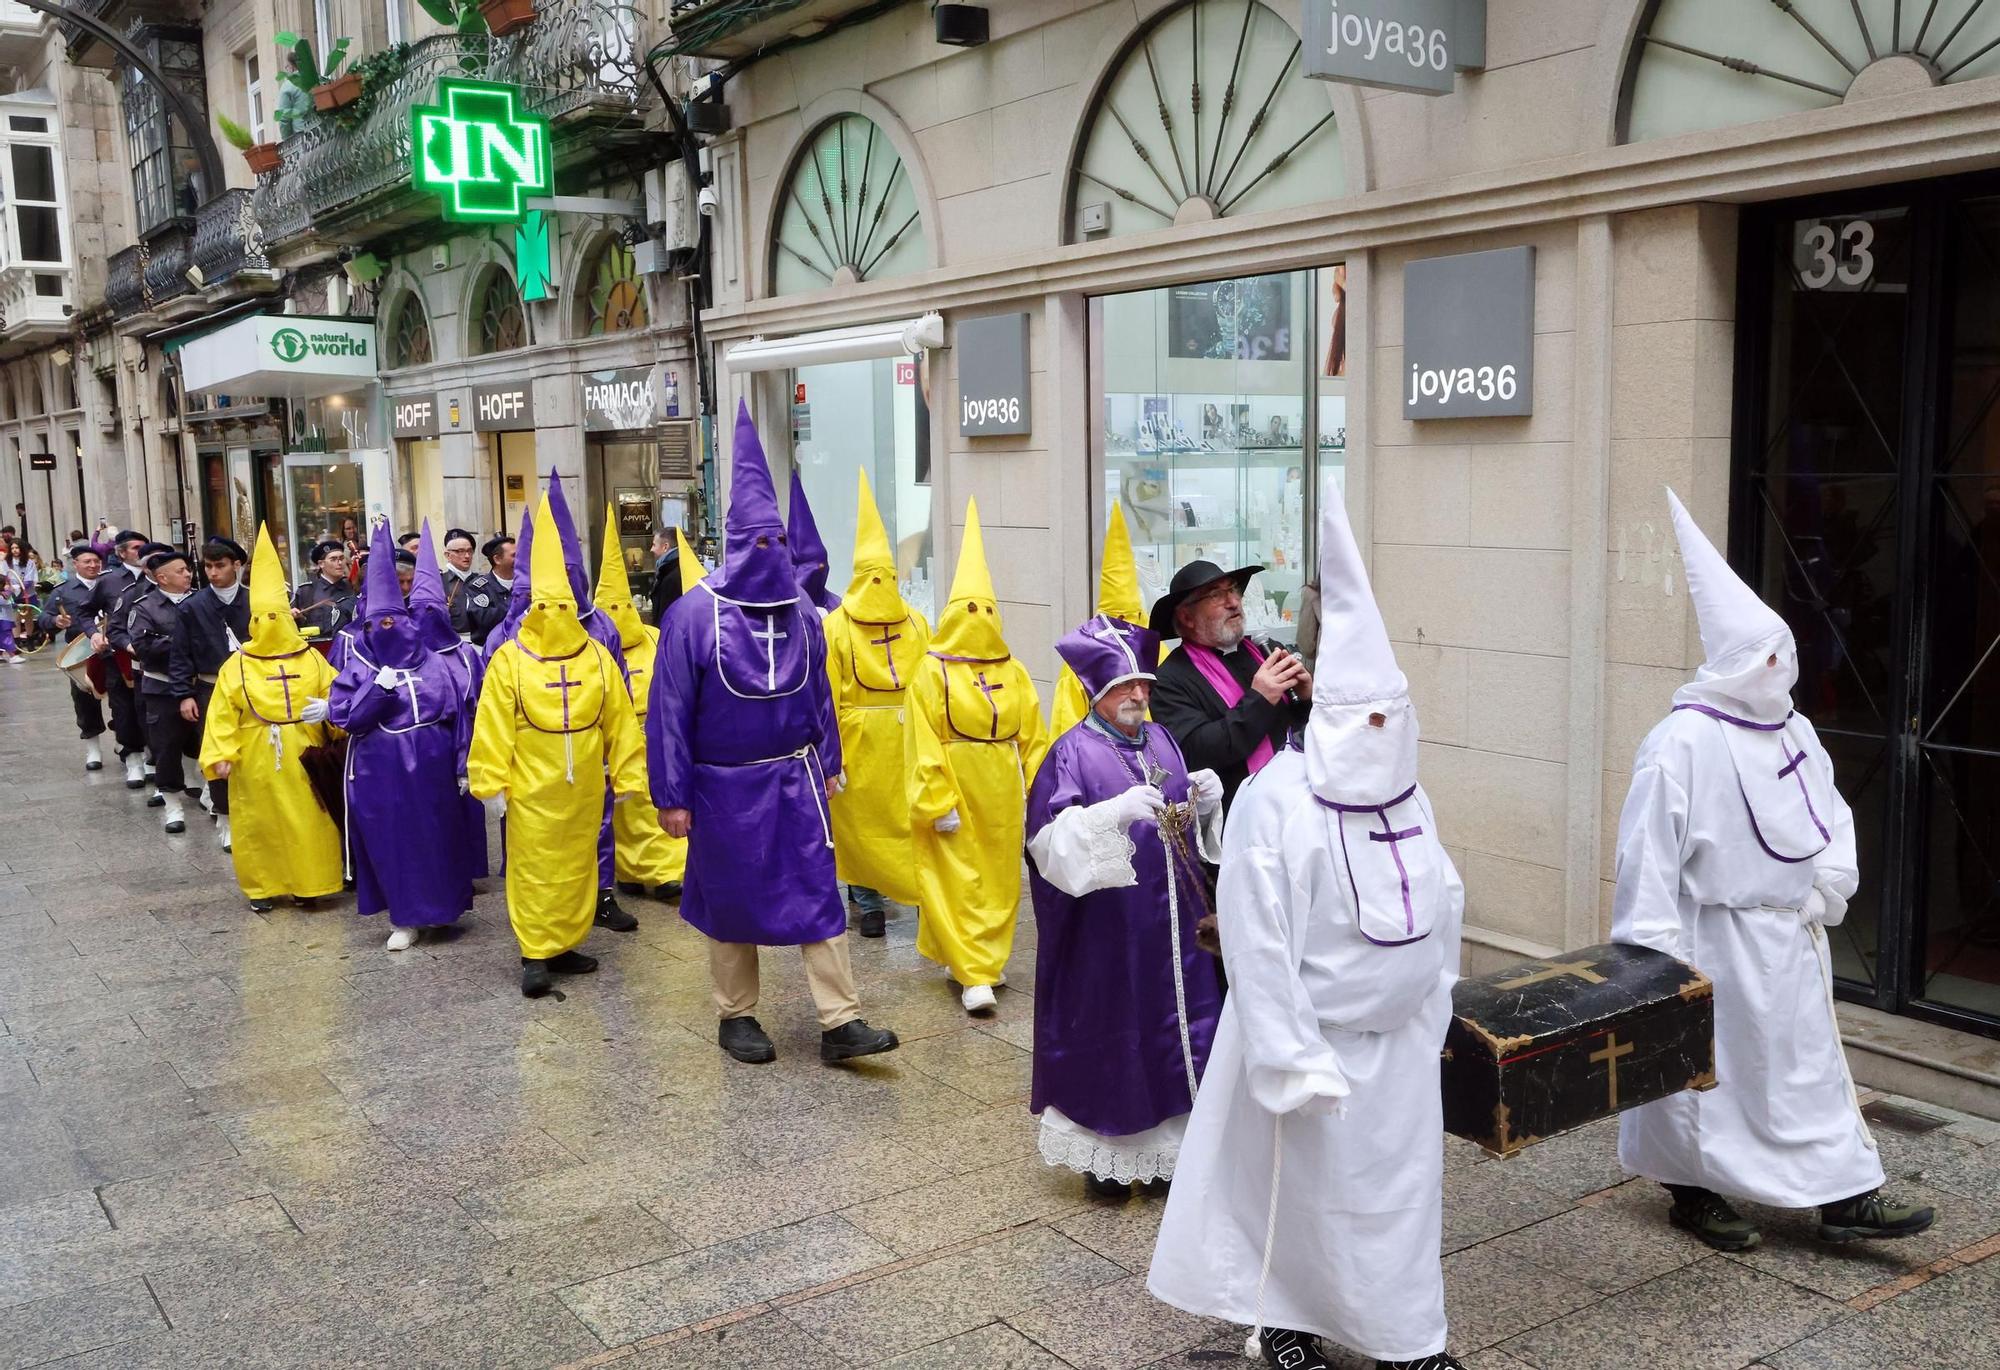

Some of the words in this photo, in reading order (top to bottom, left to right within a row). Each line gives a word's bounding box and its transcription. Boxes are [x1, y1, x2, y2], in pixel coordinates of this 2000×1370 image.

[1327, 0, 1447, 71] joya36
[1800, 220, 1874, 289] 33
[310, 332, 348, 342] natural
[311, 338, 367, 356] world
[585, 381, 655, 410] FARMACIA
[1408, 363, 1517, 405] joya36
[395, 402, 431, 428] HOFF
[480, 391, 524, 420] HOFF
[962, 395, 1019, 426] joya36
